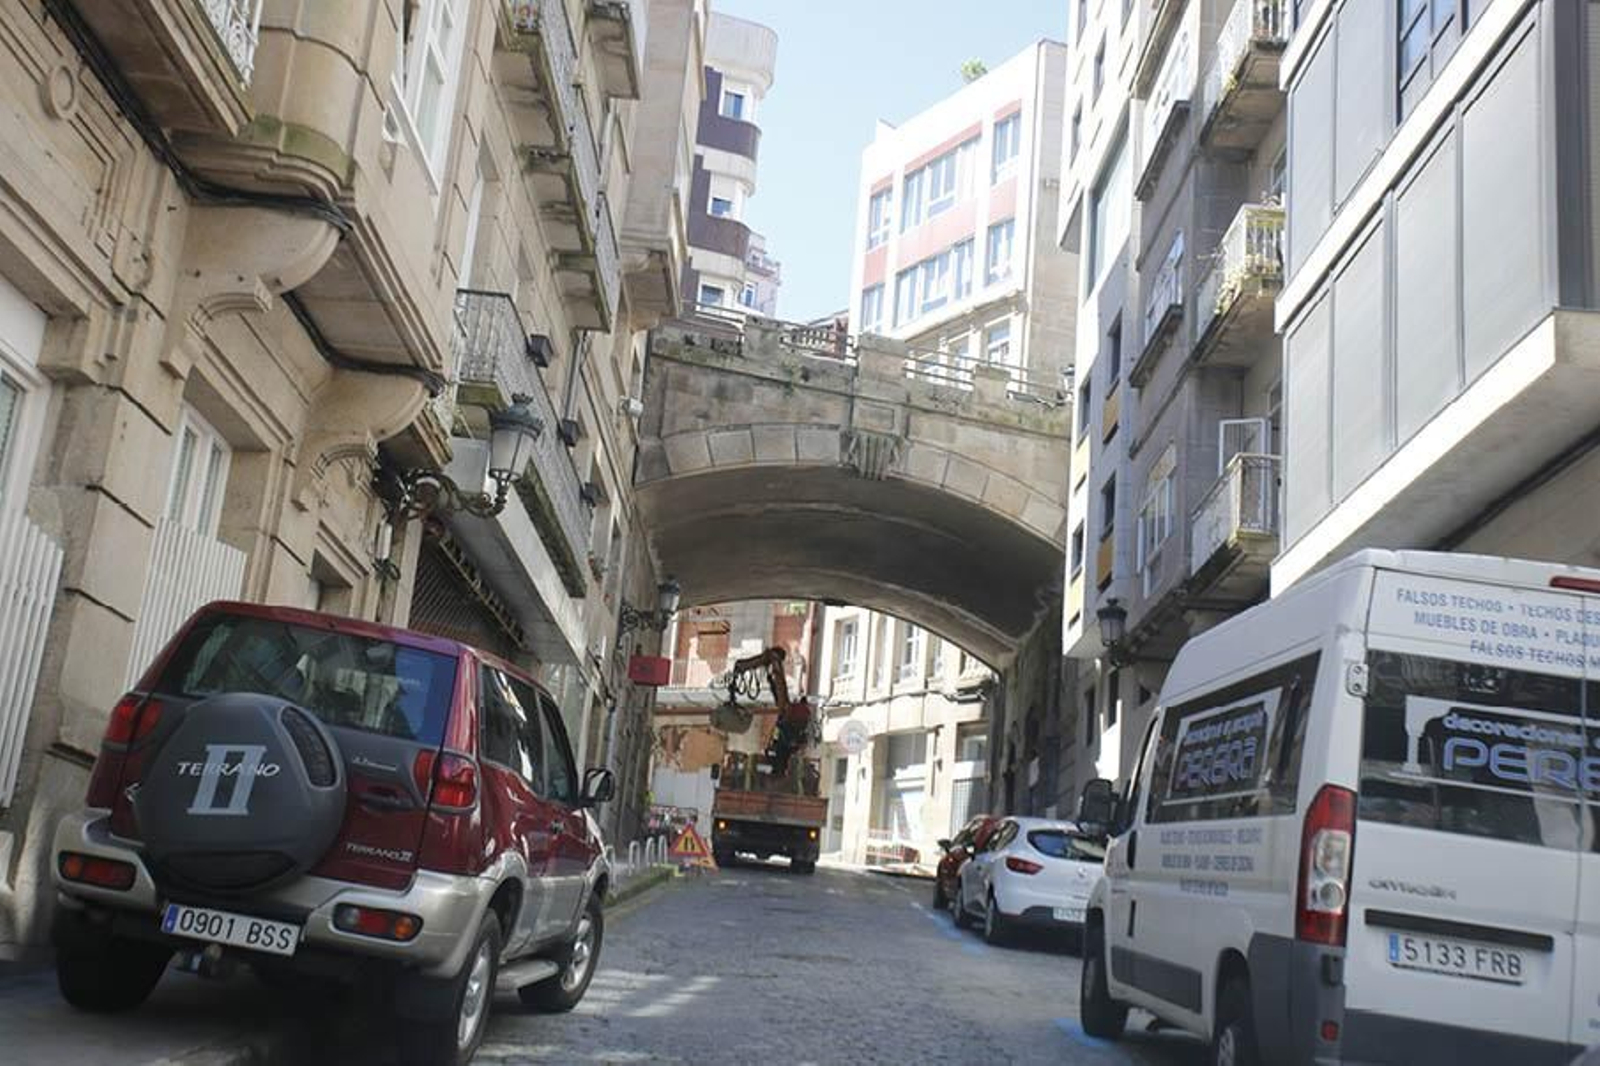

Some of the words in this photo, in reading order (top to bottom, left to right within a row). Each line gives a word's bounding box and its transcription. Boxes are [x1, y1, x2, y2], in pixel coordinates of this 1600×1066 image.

[1397, 587, 1447, 607] FALSOS
[1451, 594, 1502, 613] TECHOS
[1521, 603, 1572, 622] TECHOS
[1414, 611, 1477, 633] MUEBLES
[1481, 619, 1498, 635] DE
[1502, 622, 1538, 639] OBRA
[1470, 639, 1524, 660] FALSOS
[1529, 647, 1585, 668] TECHOS
[177, 762, 280, 777] TERRANO
[180, 909, 235, 940] 0901
[246, 921, 292, 950] BSS
[1404, 938, 1467, 970] 5133
[1475, 948, 1522, 977] FRB
